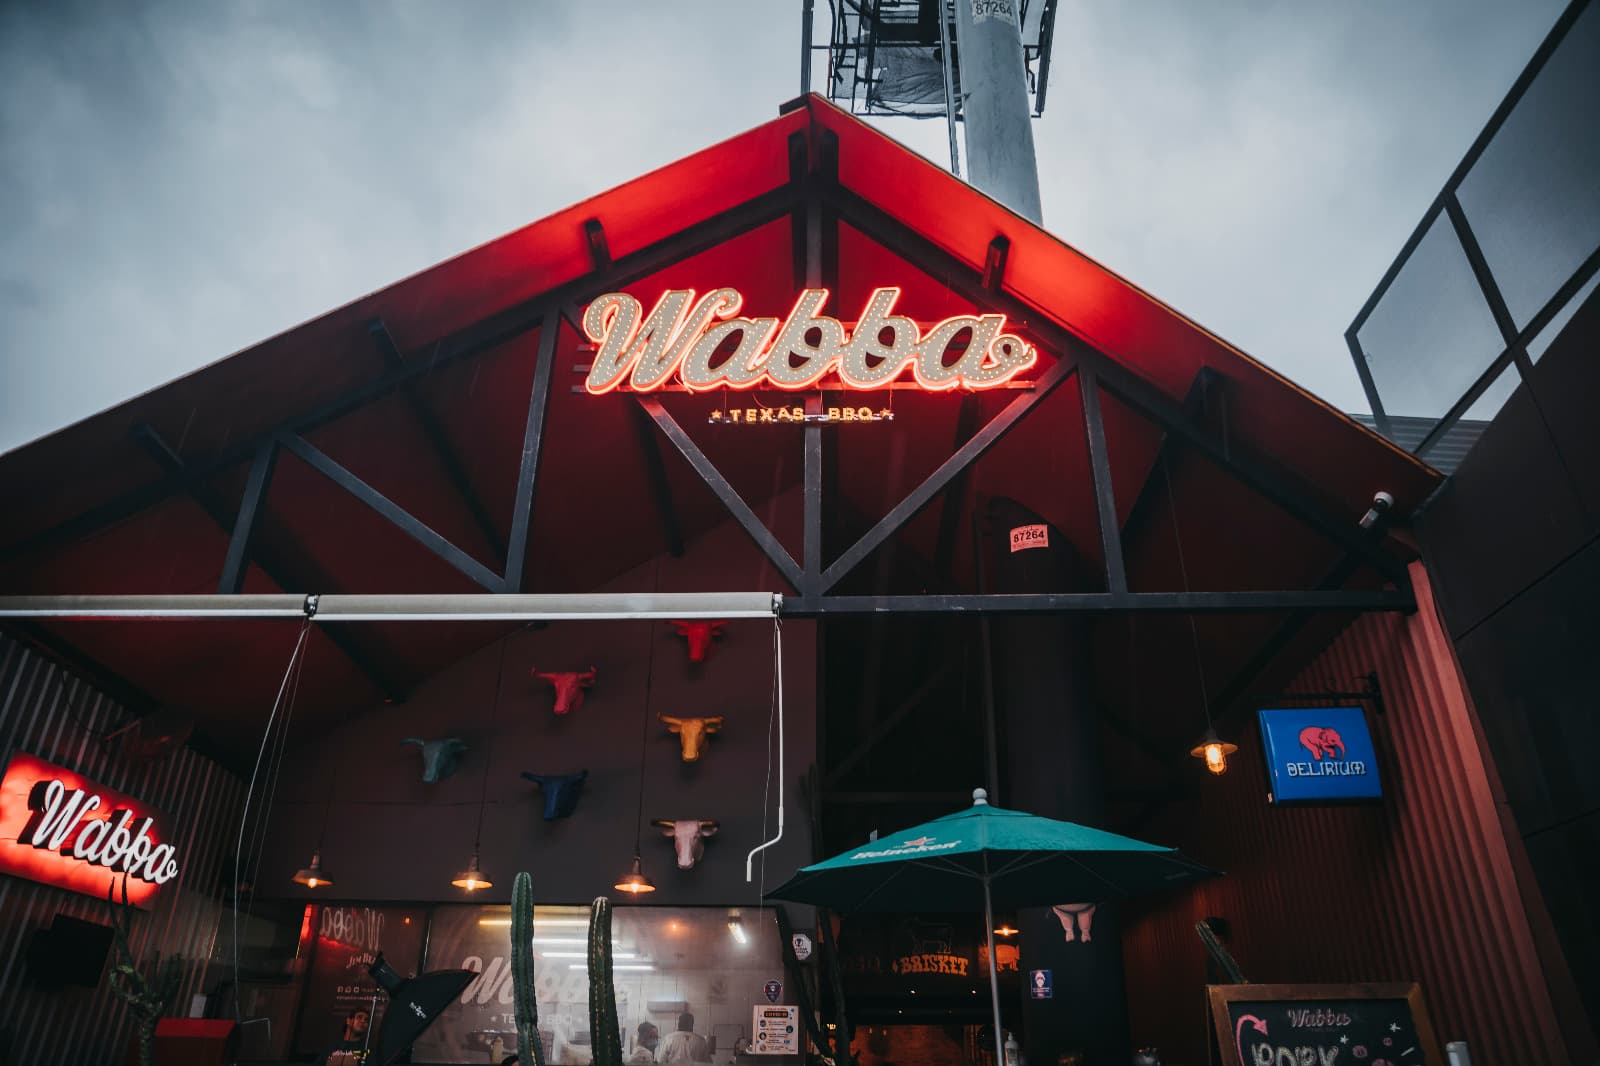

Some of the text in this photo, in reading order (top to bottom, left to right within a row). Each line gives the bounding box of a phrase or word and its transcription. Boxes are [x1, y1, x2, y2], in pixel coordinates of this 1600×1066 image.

[976, 1, 1012, 16] 87264
[583, 287, 1037, 394] Wabba
[730, 406, 873, 424] TEXAS BBQ
[1013, 530, 1044, 543] 87264
[1286, 761, 1366, 777] DELIRIUM
[32, 779, 178, 885] Wabba
[900, 954, 969, 976] BRISKET
[1287, 1008, 1352, 1029] Wabba
